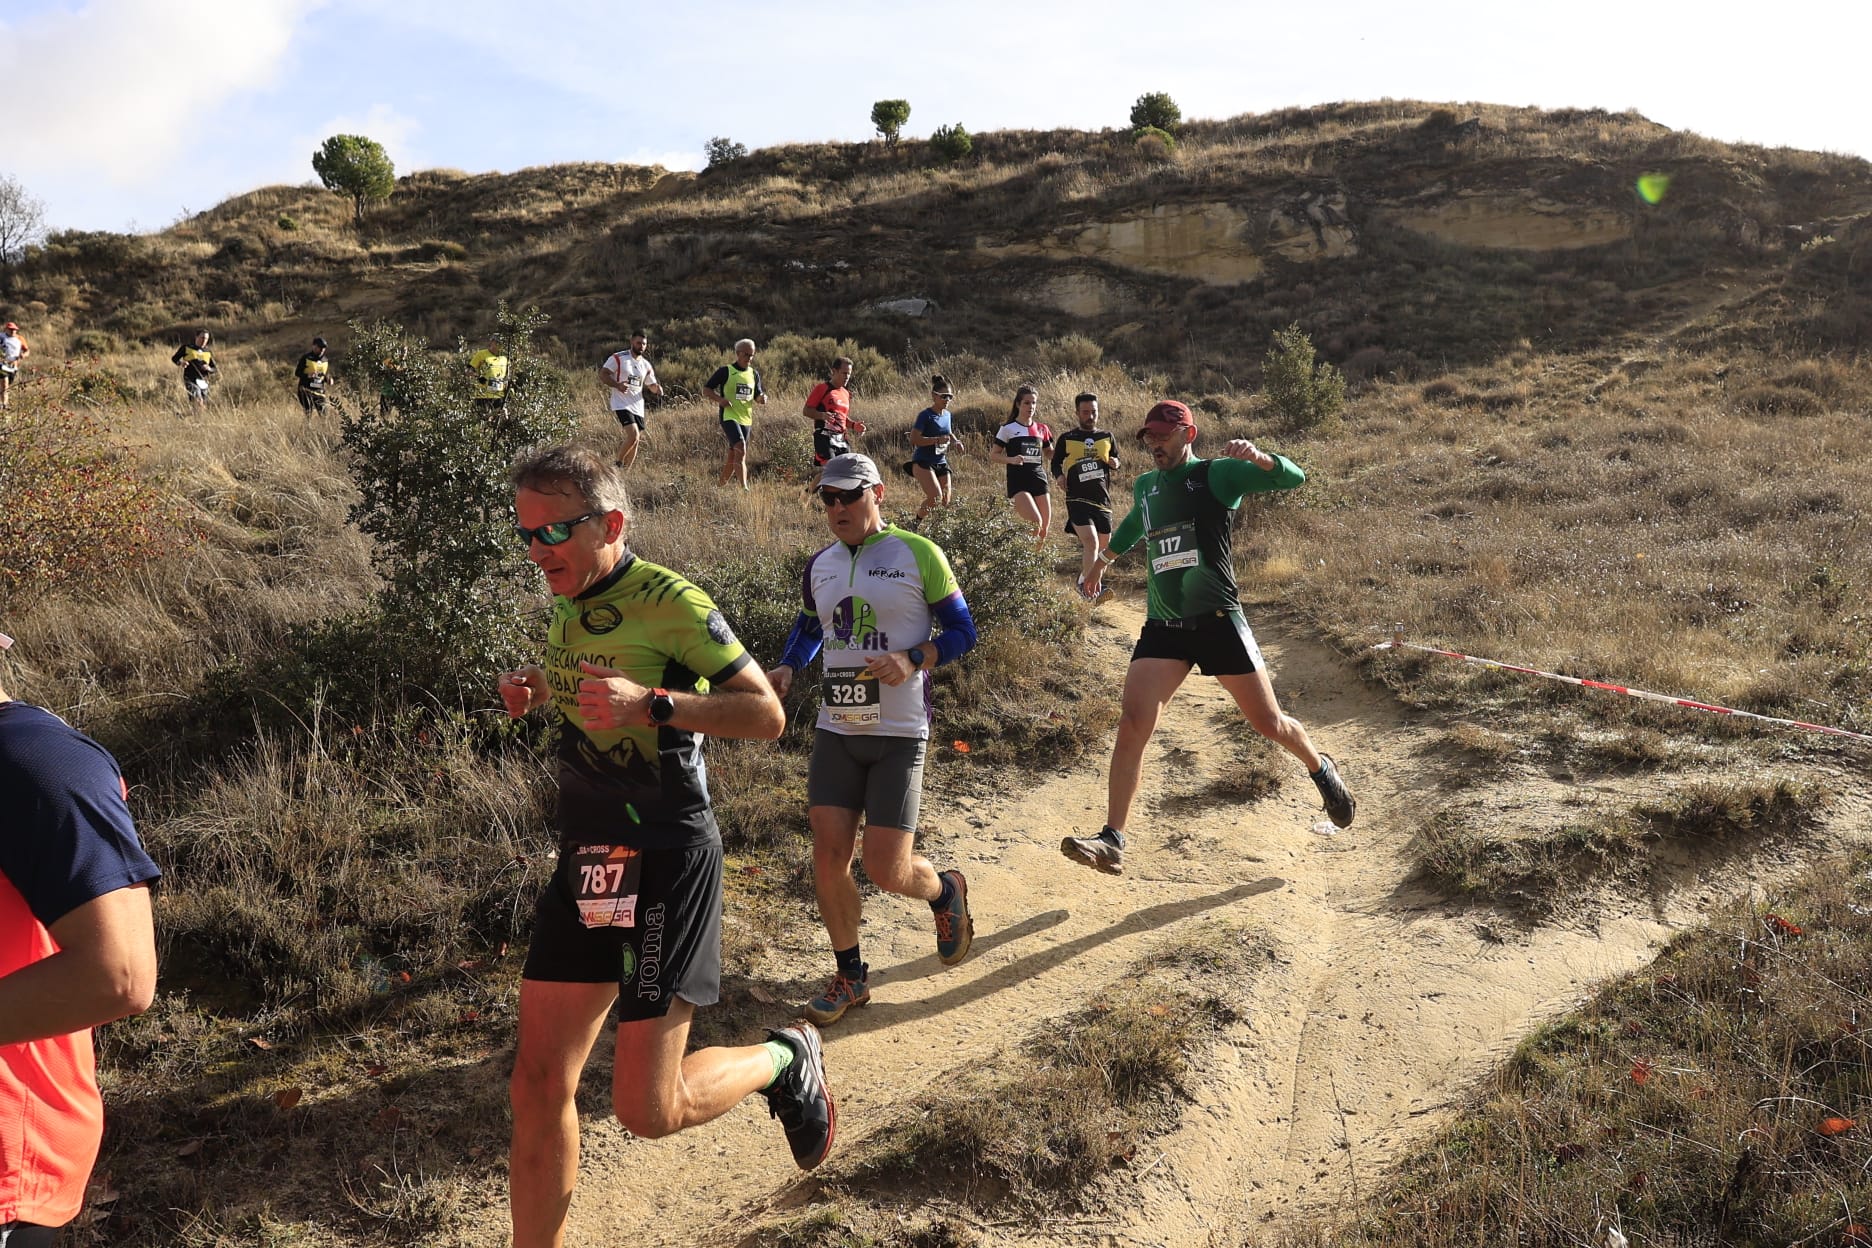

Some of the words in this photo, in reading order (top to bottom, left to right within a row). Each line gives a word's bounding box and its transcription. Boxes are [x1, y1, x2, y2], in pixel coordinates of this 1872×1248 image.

[1026, 447, 1039, 456] 477
[1081, 461, 1098, 472] 690
[1158, 535, 1181, 554] 117
[863, 631, 889, 651] fit
[831, 684, 867, 704] 328
[580, 863, 625, 894] 787
[638, 902, 666, 1002] Joma
